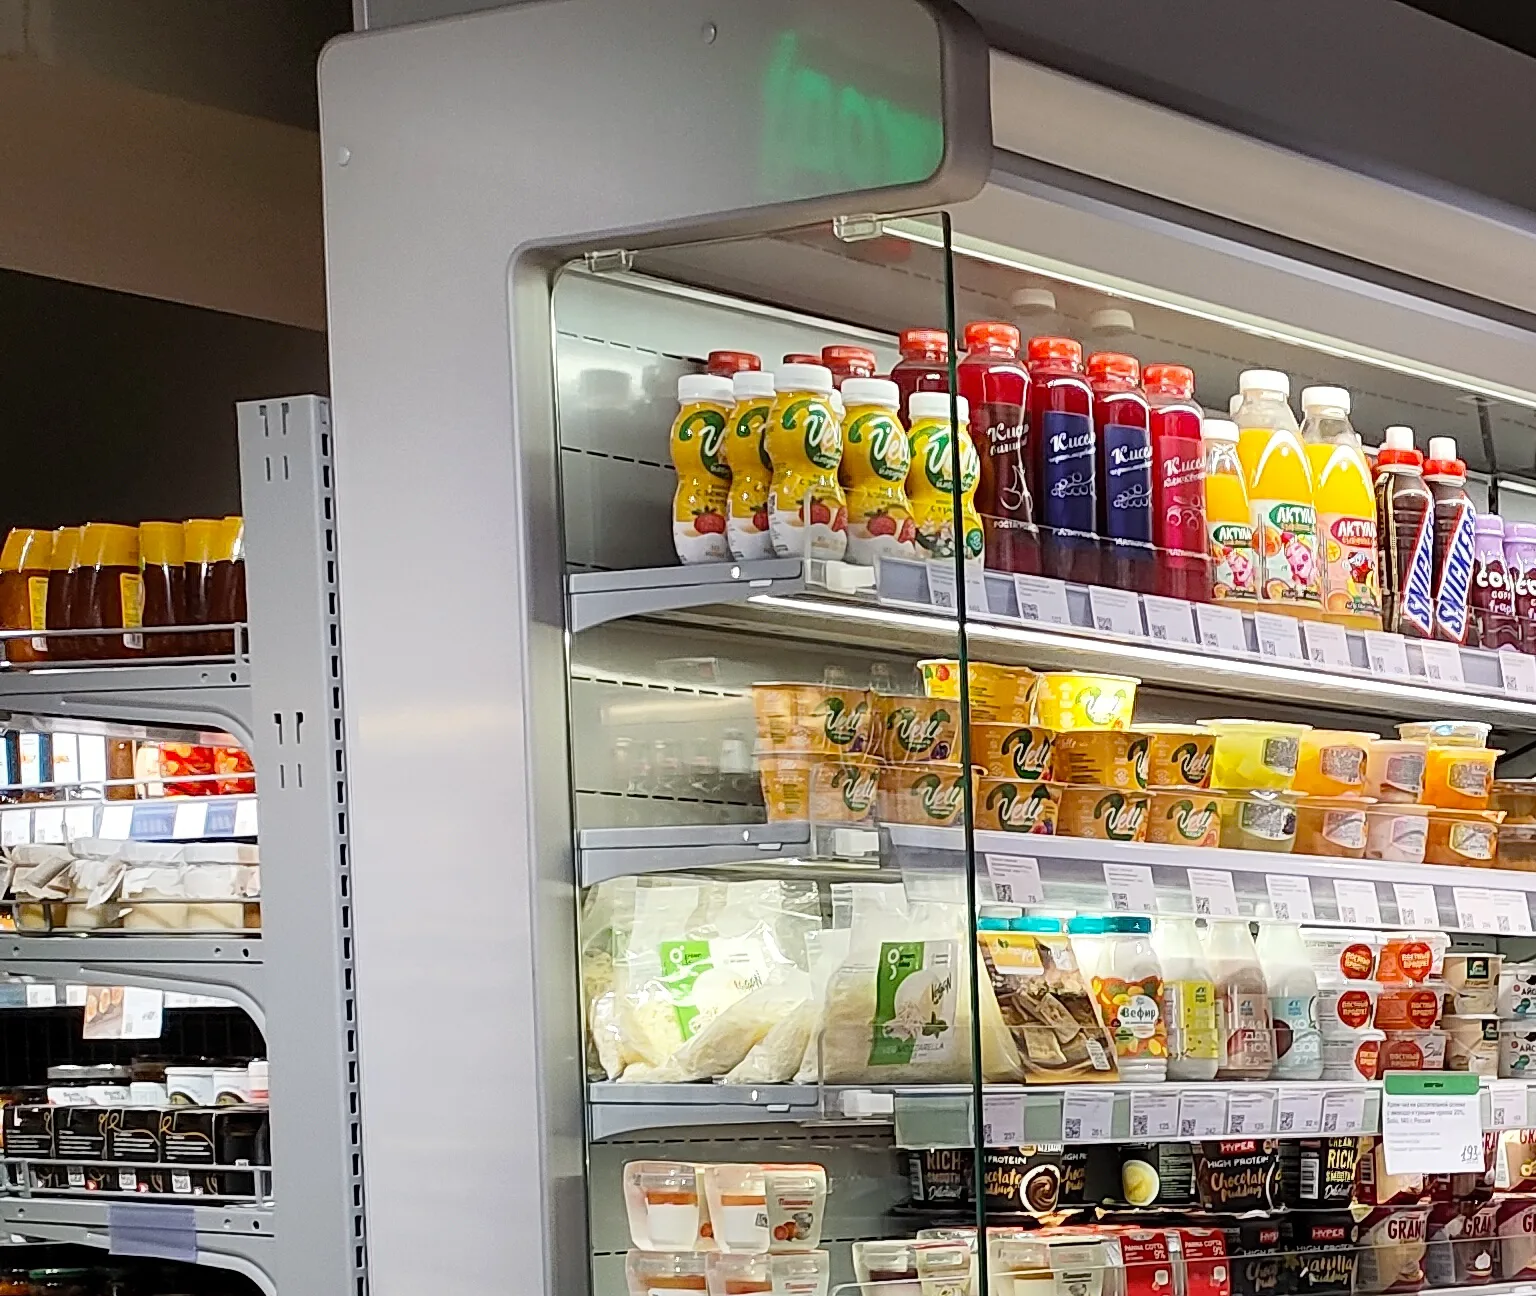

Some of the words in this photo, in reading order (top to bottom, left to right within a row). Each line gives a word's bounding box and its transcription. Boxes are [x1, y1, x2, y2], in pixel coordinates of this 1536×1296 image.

[1405, 508, 1434, 629] SNICKE
[1437, 504, 1477, 634] SNICKERS
[1220, 1141, 1255, 1153] HYPER
[1327, 1148, 1354, 1170] RICH
[1312, 1227, 1345, 1239] HYPER
[1387, 1219, 1427, 1240] GRAN
